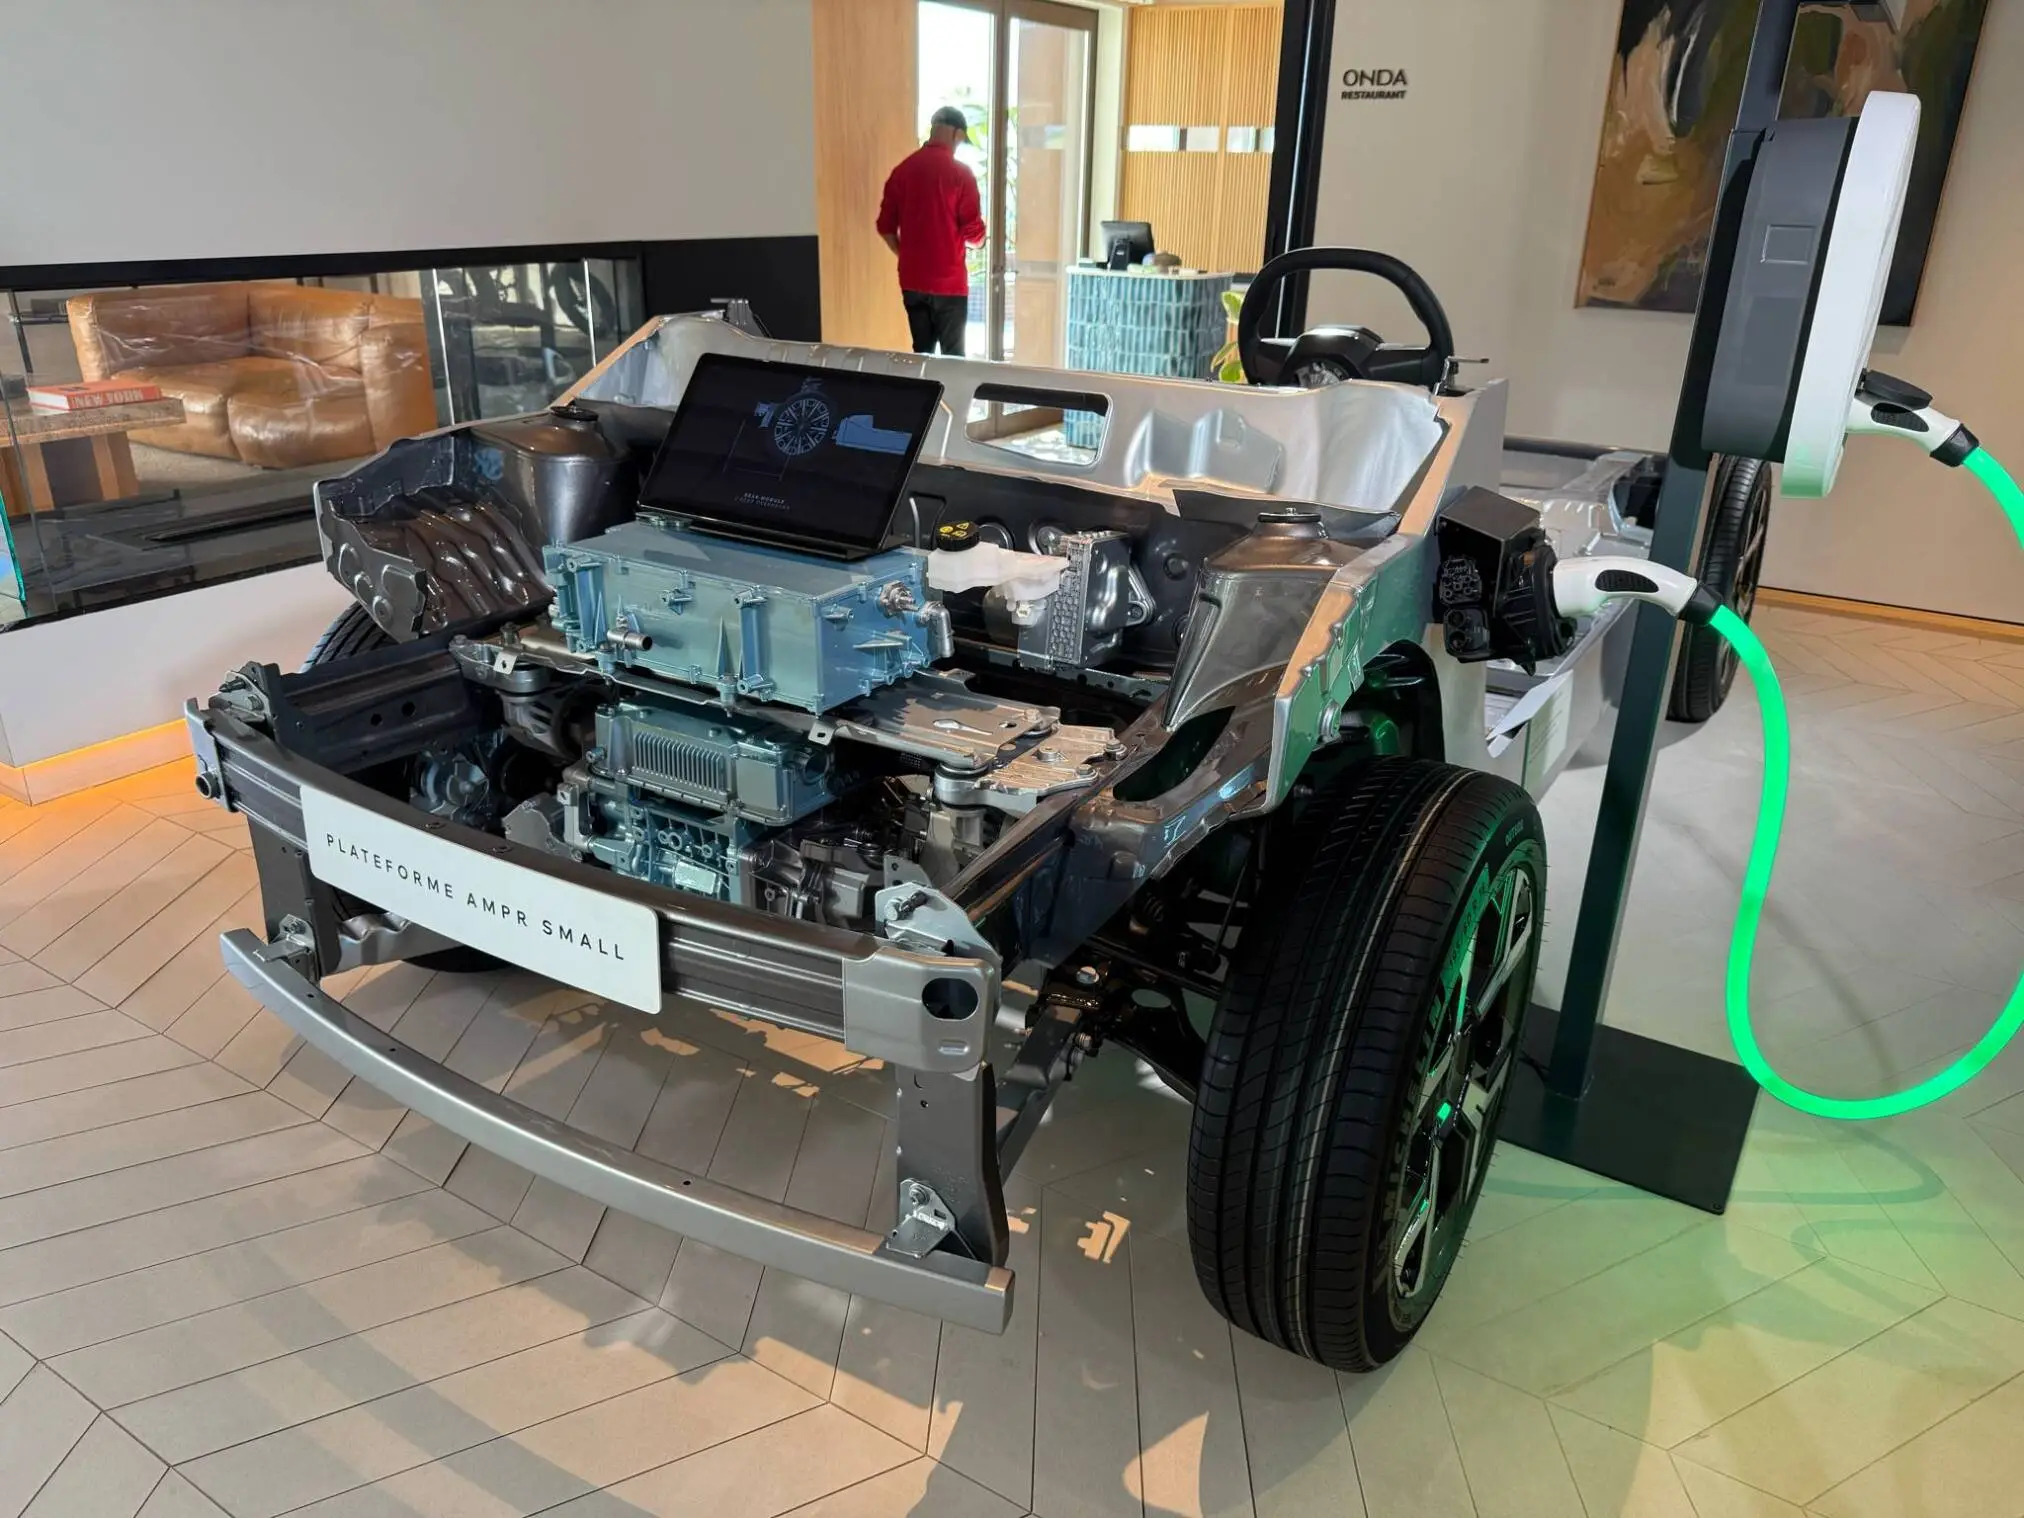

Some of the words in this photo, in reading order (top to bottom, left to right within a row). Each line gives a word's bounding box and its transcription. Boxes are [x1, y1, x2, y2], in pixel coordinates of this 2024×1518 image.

[1341, 90, 1407, 100] RESTAURANT
[1342, 69, 1407, 87] ONDA
[326, 832, 454, 899] PLATEFORME
[466, 892, 528, 927] AMPR
[542, 919, 625, 961] SMALL
[1383, 995, 1442, 1221] MICHELIN
